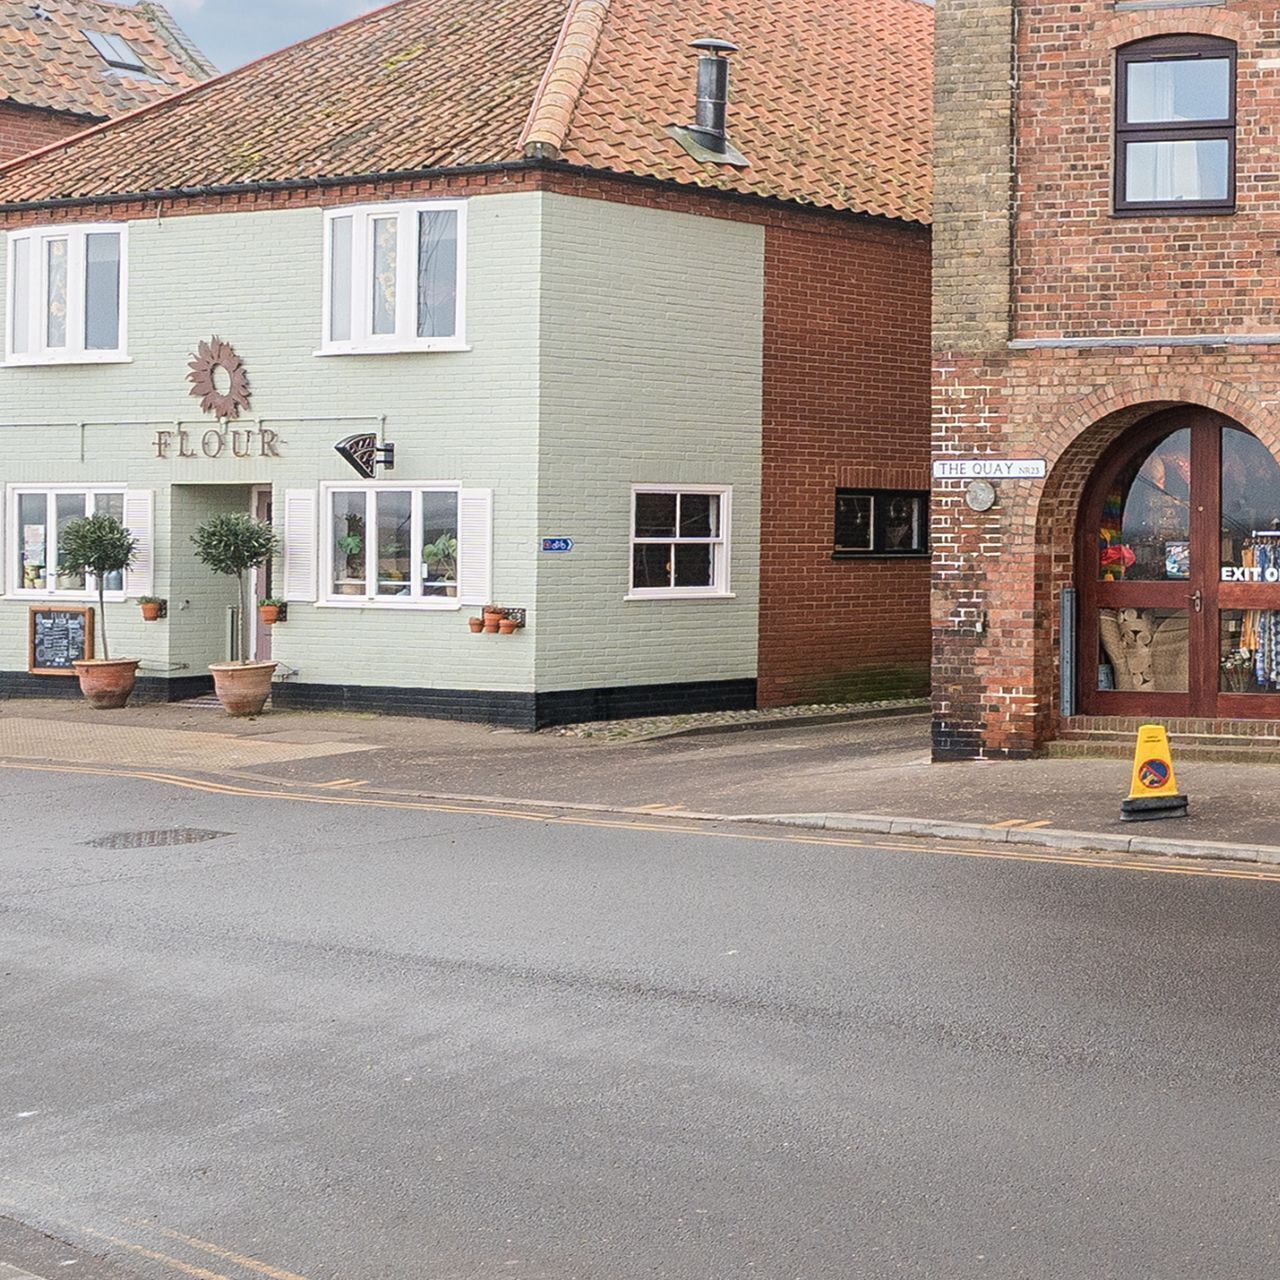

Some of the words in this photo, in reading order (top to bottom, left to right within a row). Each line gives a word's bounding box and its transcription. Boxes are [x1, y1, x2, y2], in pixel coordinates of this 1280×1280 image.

[152, 429, 281, 458] FLOUR
[939, 463, 966, 475] THE
[972, 463, 1014, 476] QUAY
[1018, 466, 1040, 475] NR23
[1221, 567, 1262, 582] EXIT
